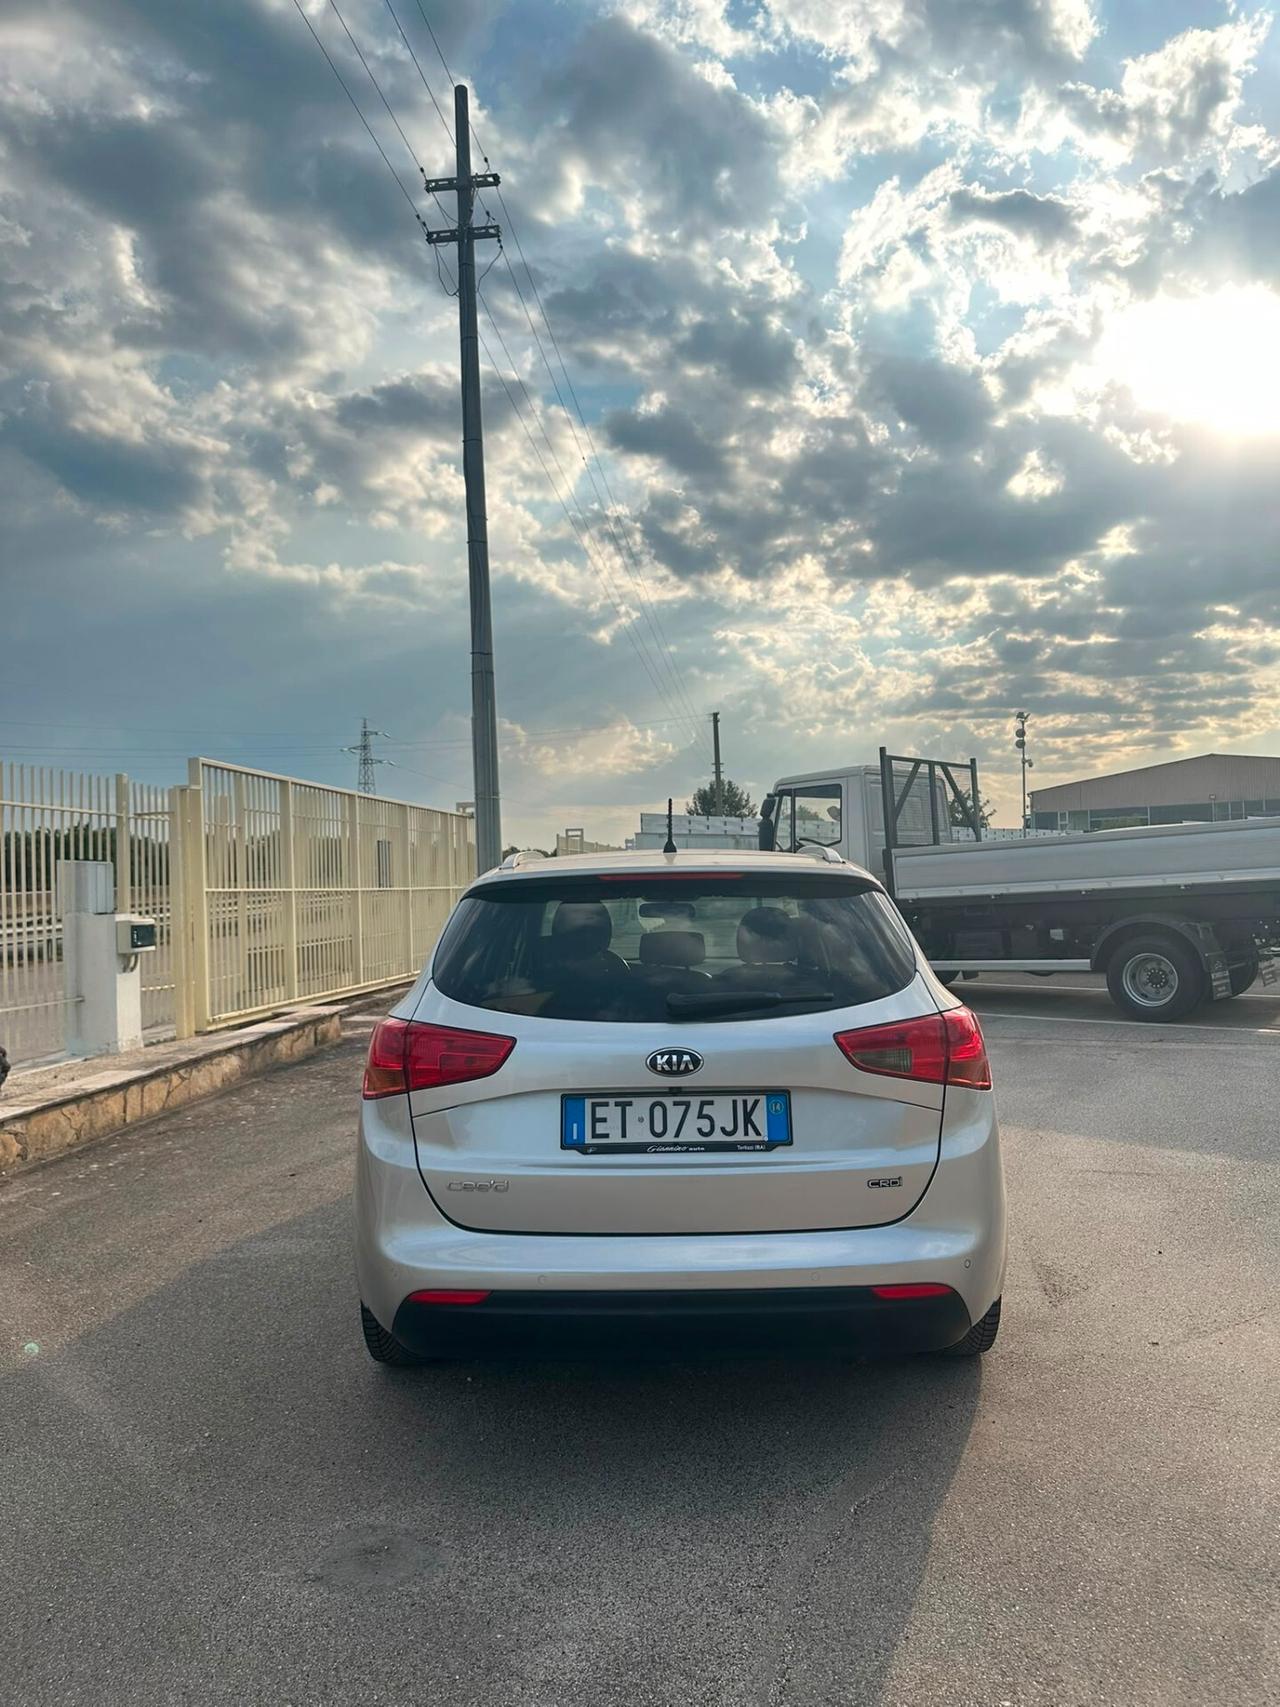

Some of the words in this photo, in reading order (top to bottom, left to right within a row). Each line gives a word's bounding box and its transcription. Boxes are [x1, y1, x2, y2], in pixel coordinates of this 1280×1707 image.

[656, 1054, 695, 1071] KIA
[590, 1101, 633, 1139] ET
[649, 1098, 763, 1138] 075JK
